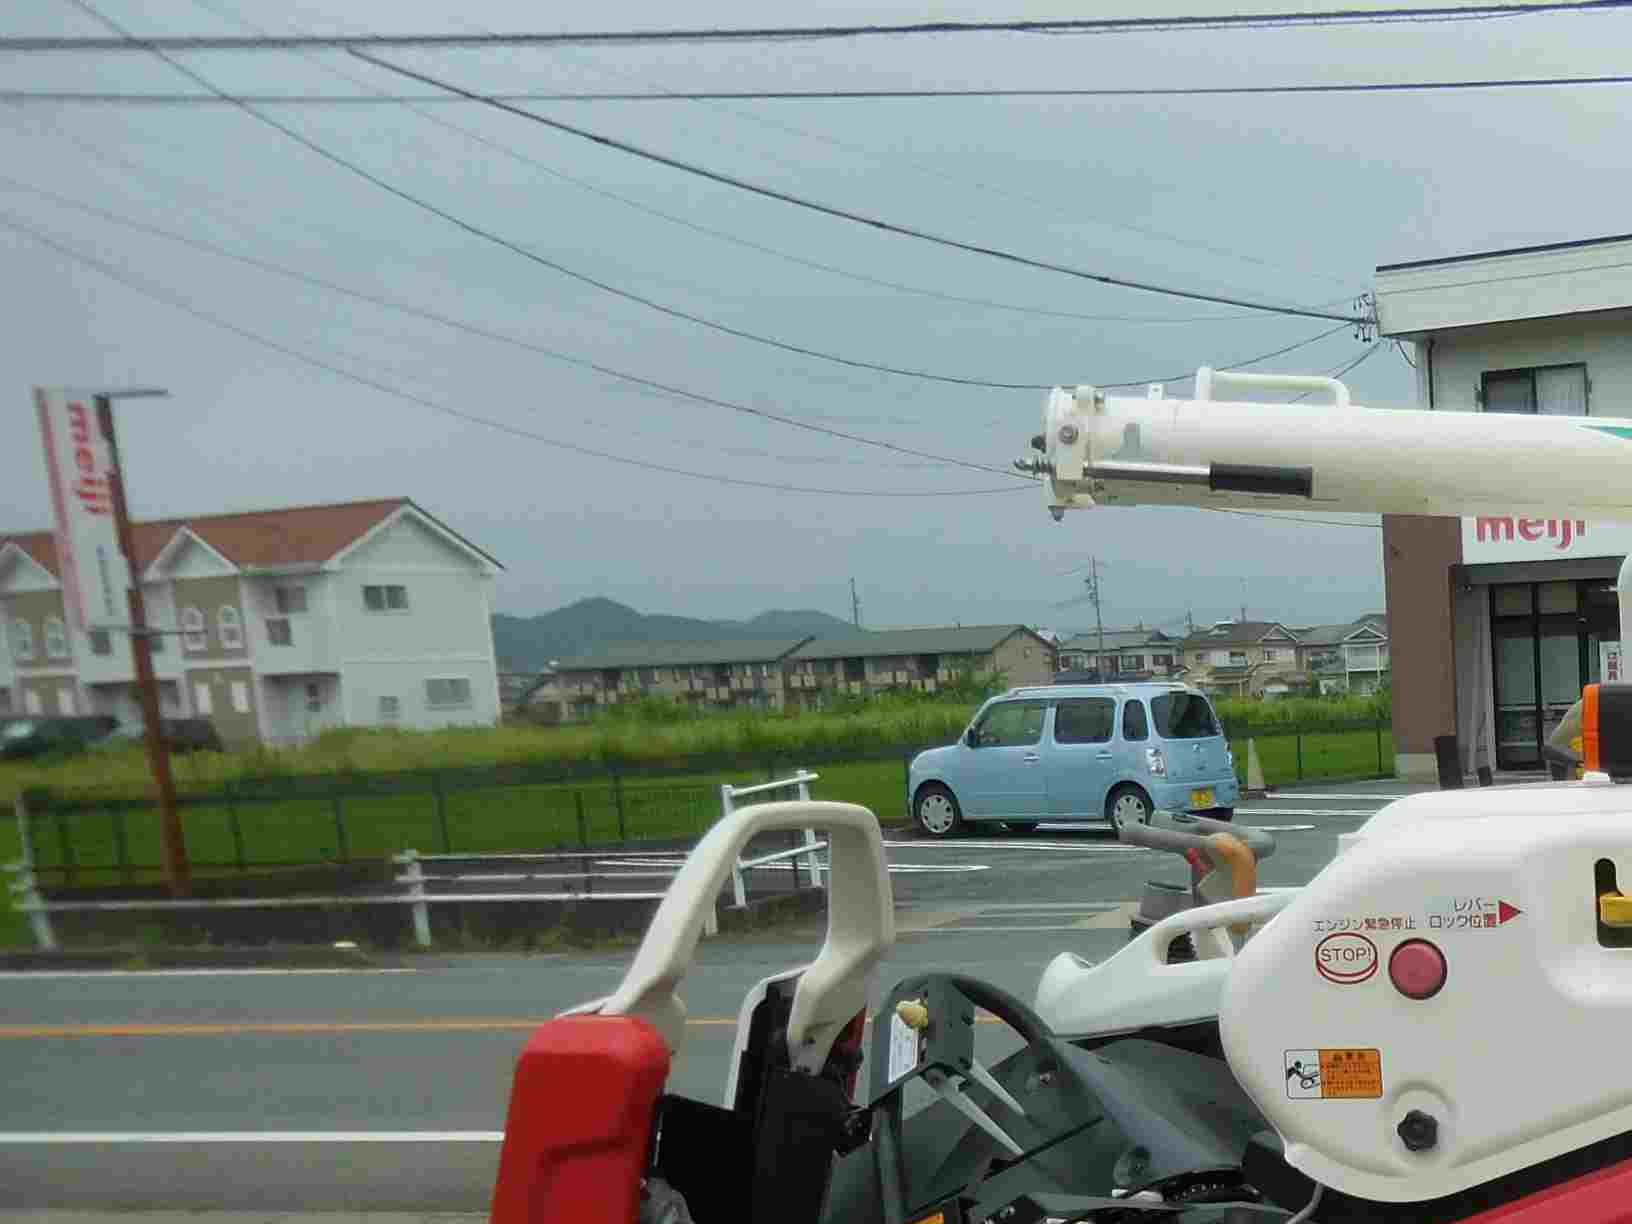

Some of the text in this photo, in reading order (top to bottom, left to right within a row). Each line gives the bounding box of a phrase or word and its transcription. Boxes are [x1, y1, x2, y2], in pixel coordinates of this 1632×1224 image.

[1453, 897, 1496, 911] レバー
[1313, 916, 1416, 932] エンジン緊急停止
[1429, 913, 1496, 929] ロック位置
[1320, 946, 1371, 962] STOP!
